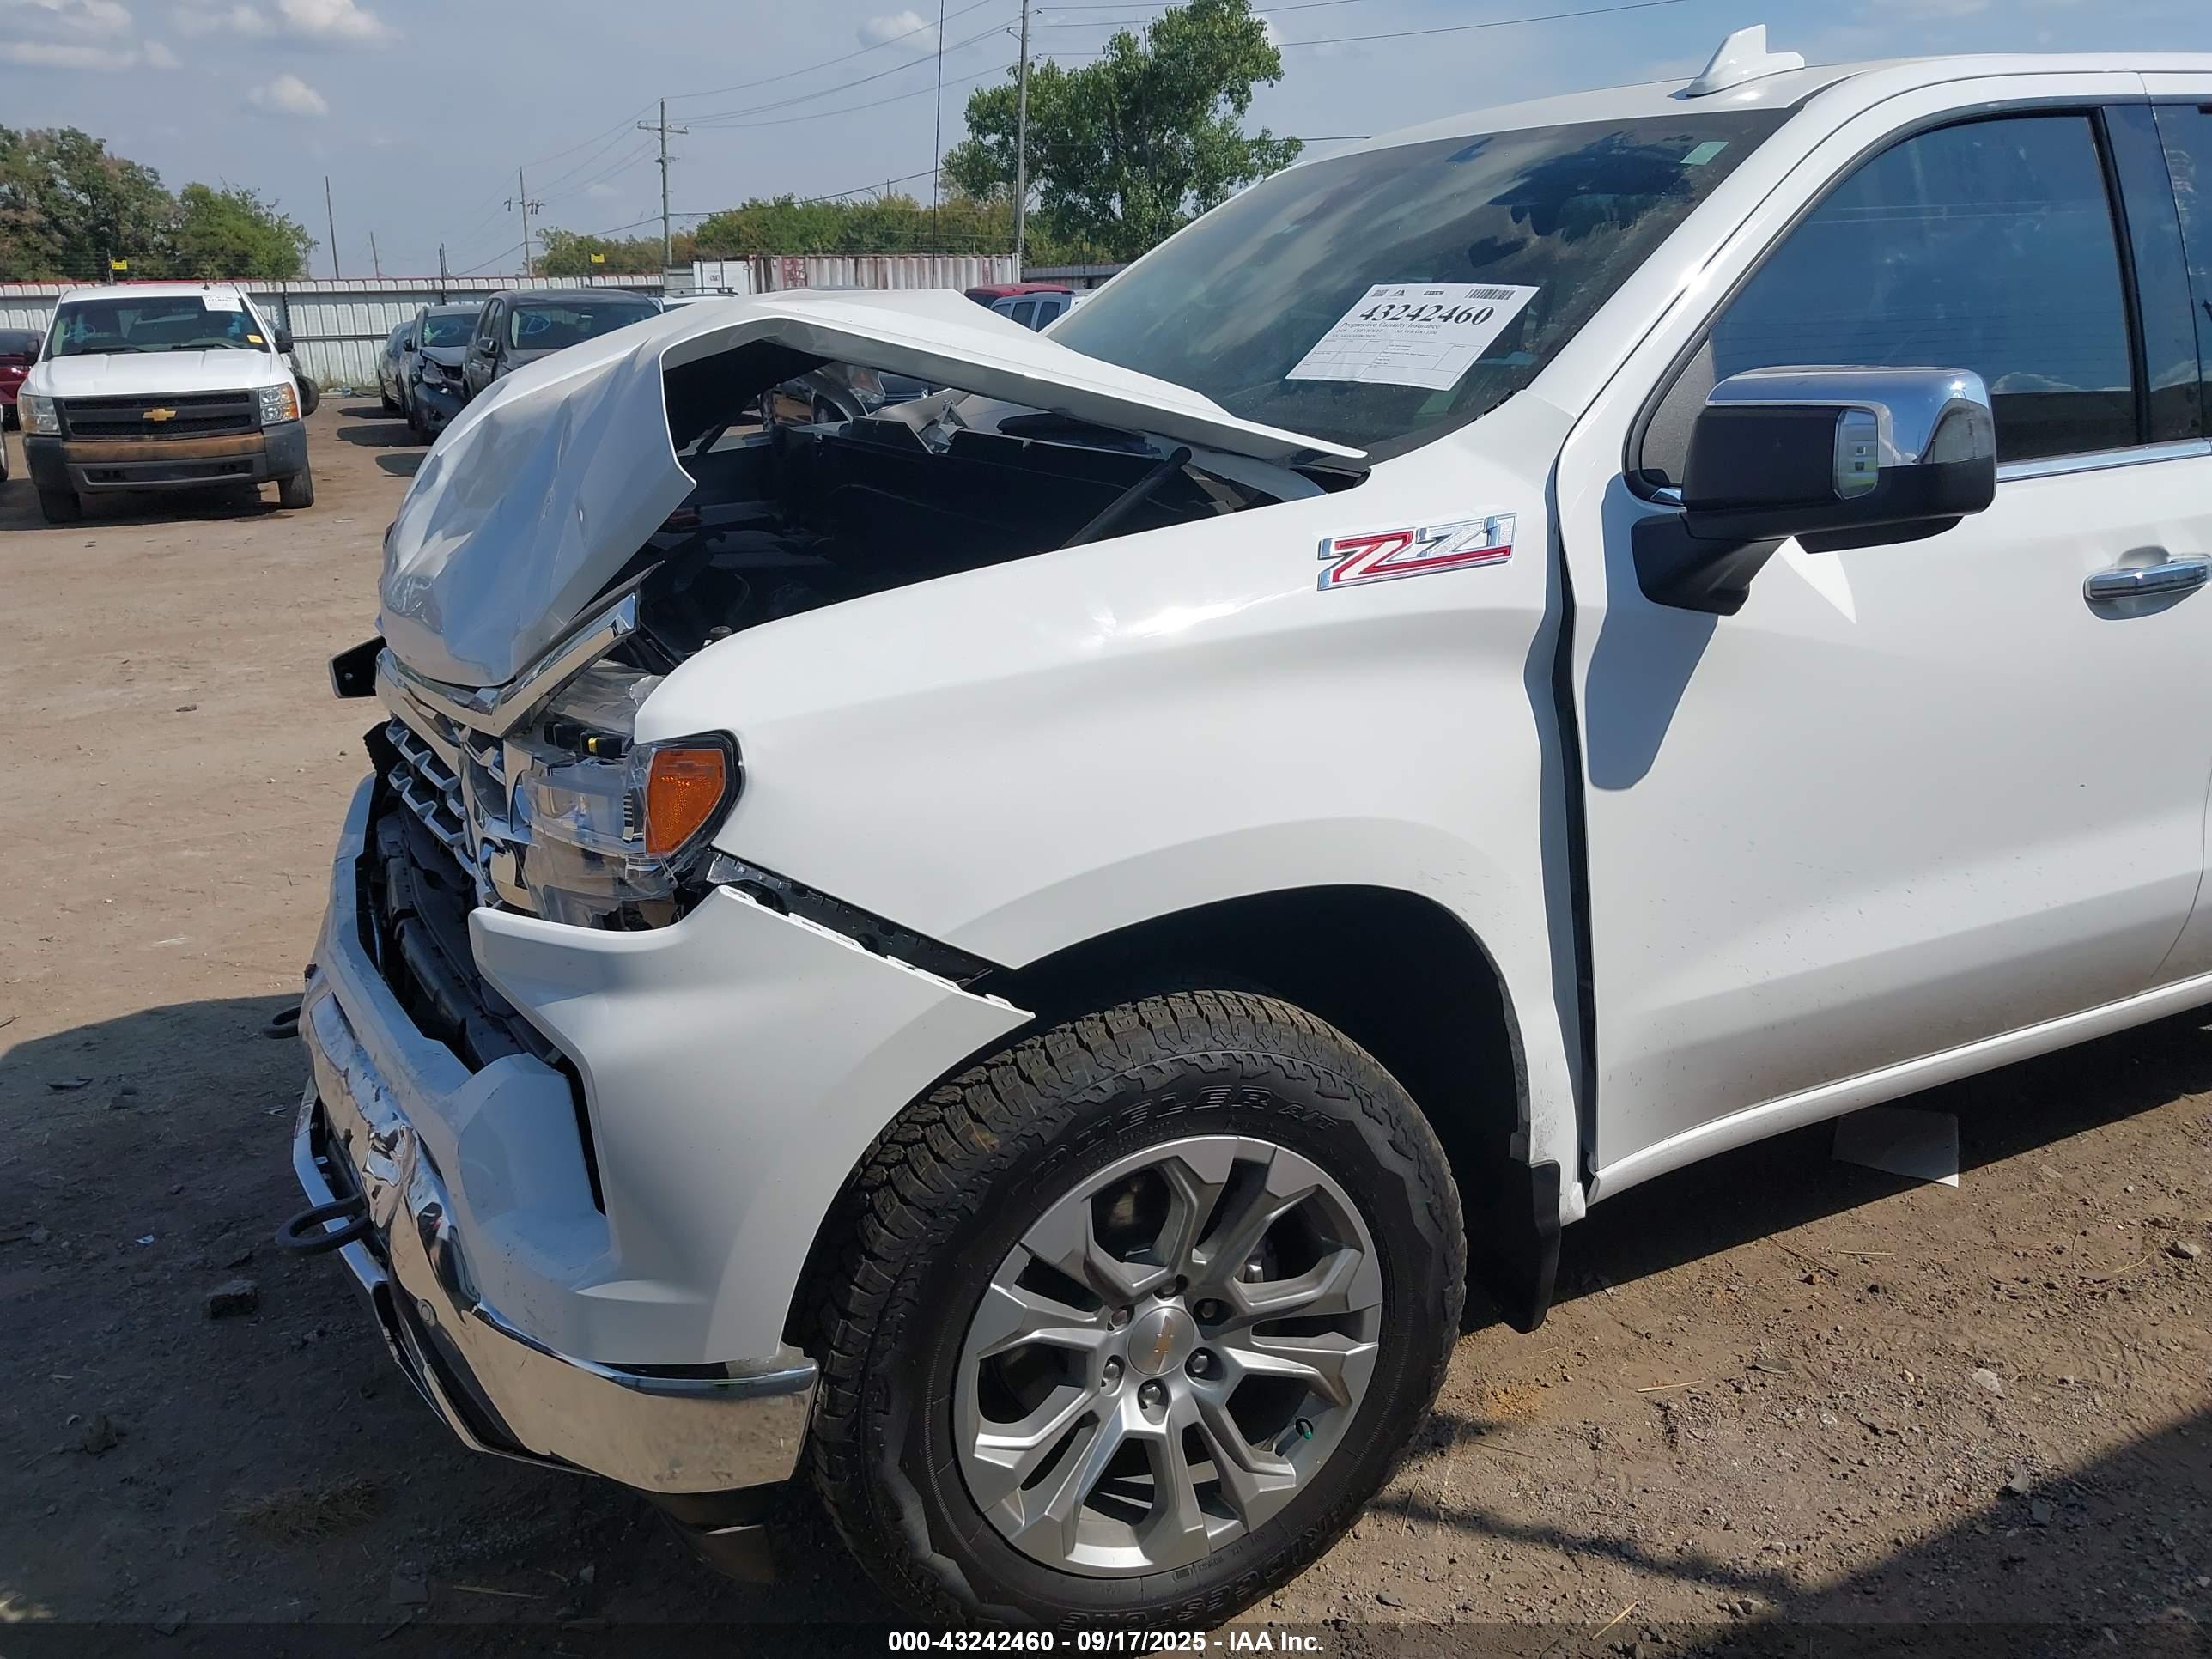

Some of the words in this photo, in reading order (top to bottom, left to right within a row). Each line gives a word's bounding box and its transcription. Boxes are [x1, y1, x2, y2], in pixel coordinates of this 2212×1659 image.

[1359, 303, 1495, 325] 43242460
[1340, 321, 1378, 330] Progressive
[1407, 322, 1442, 331] Insurance
[1317, 511, 1517, 592] Z71
